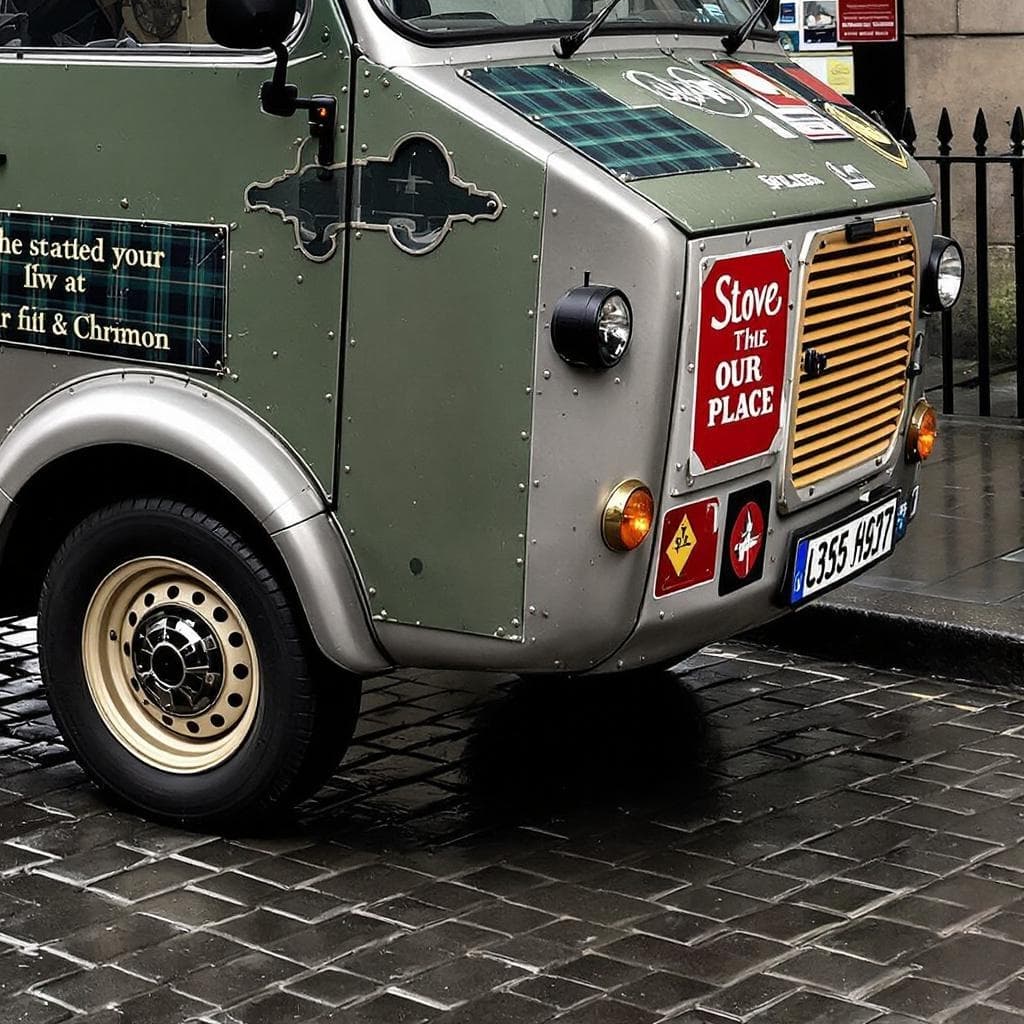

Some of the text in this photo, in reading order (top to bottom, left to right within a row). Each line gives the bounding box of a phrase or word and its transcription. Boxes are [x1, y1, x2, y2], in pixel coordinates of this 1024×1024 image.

[111, 246, 166, 270] your
[64, 273, 87, 293] at
[710, 274, 783, 331] Stove
[52, 312, 69, 336] &
[714, 354, 763, 391] OUR
[706, 385, 775, 428] PLACE
